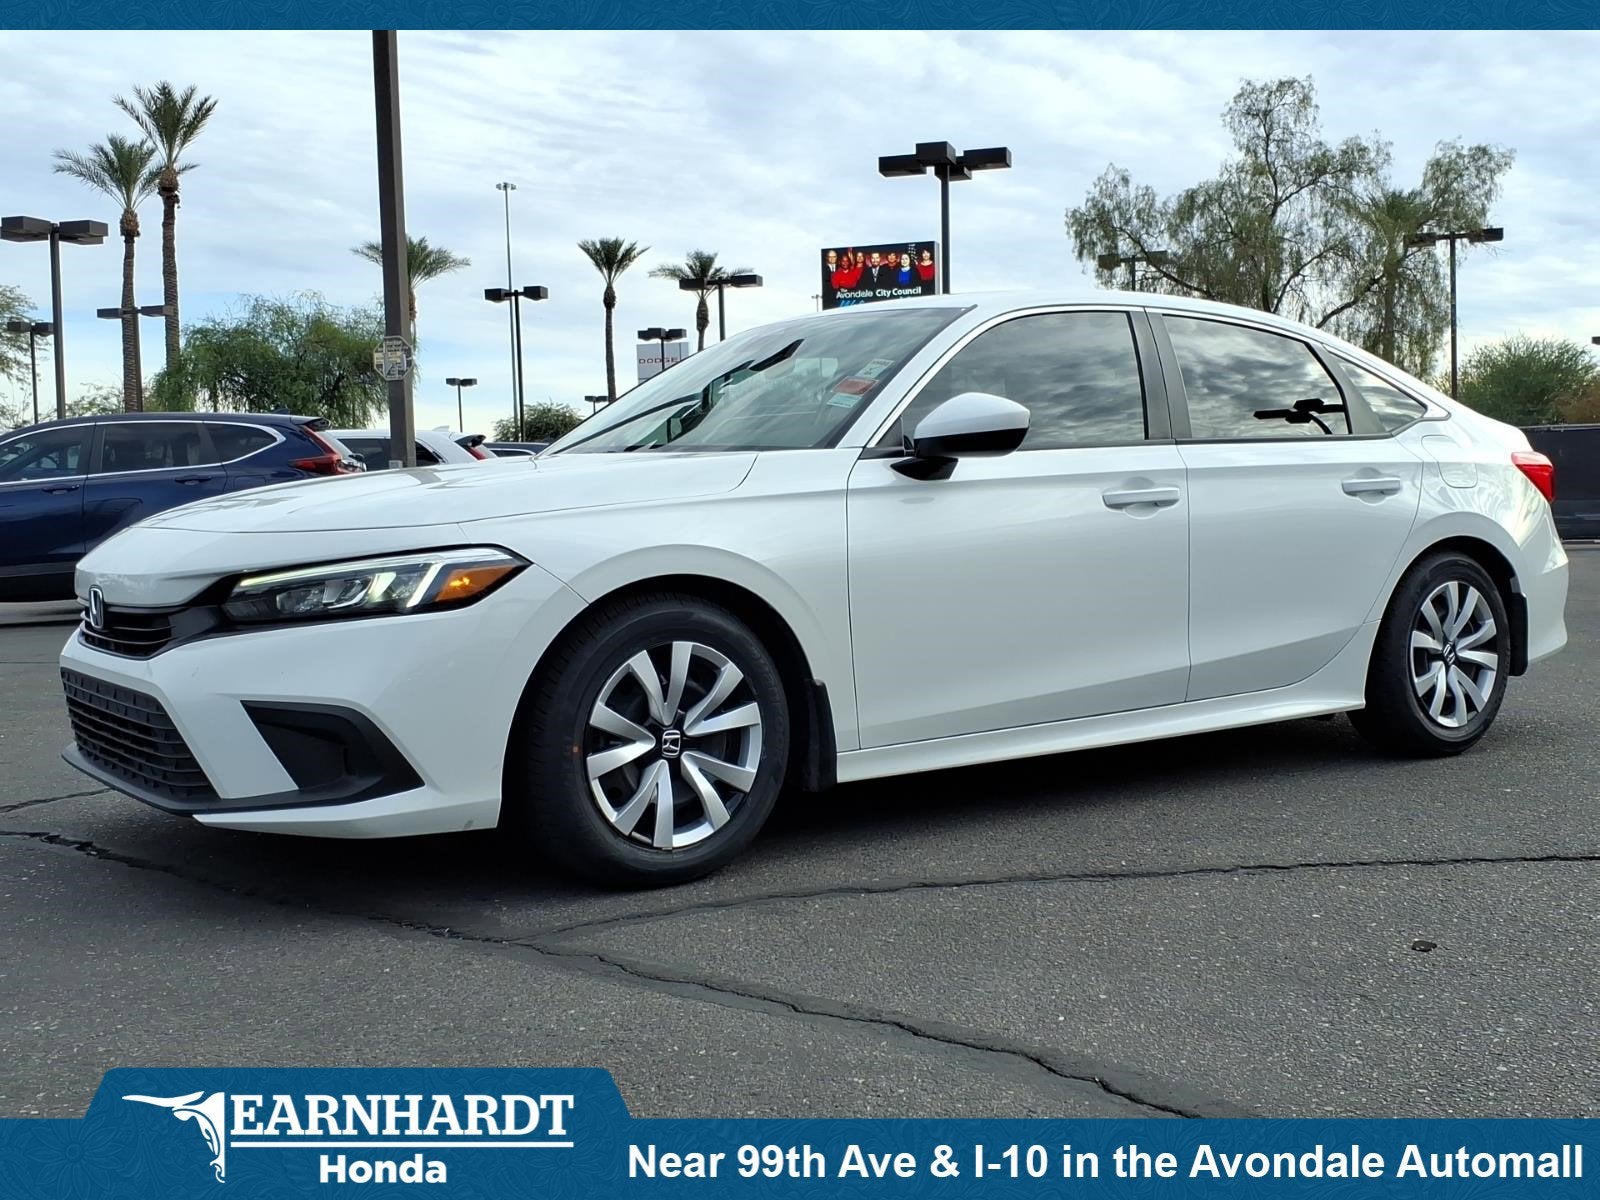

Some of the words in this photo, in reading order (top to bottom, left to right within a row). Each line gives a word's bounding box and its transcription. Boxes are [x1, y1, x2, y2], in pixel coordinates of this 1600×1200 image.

[836, 290, 874, 299] Avondale
[875, 289, 891, 298] City
[892, 286, 922, 296] Council
[638, 357, 679, 365] DODGE
